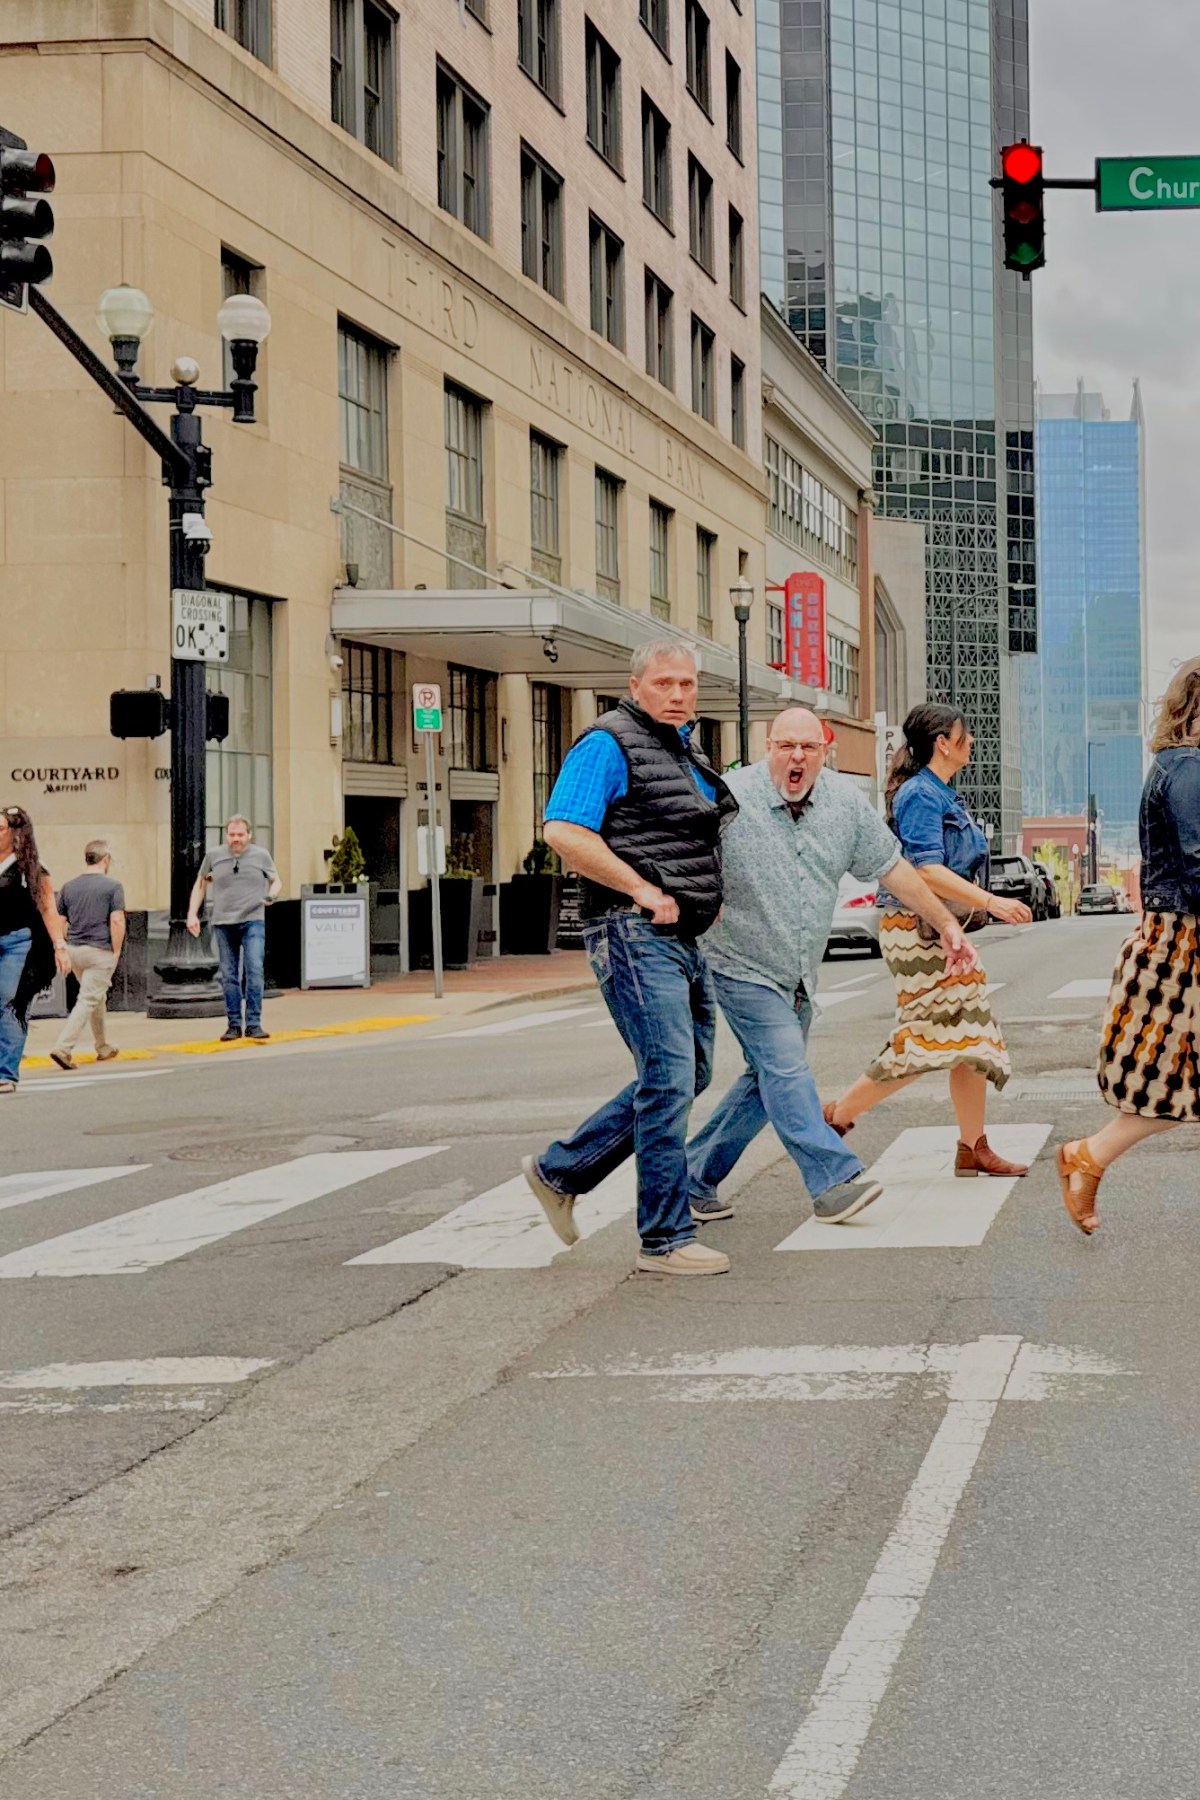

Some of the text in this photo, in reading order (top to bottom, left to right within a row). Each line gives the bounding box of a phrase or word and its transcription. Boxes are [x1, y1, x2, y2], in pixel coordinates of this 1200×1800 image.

[381, 237, 706, 500] THIRD NATIONAL BANK
[180, 593, 223, 610] DIAGONAL
[181, 606, 222, 623] CROSSING
[176, 624, 197, 649] OK
[10, 766, 120, 782] COURTYARD
[43, 783, 87, 794] Marriott
[315, 921, 358, 933] VALET
